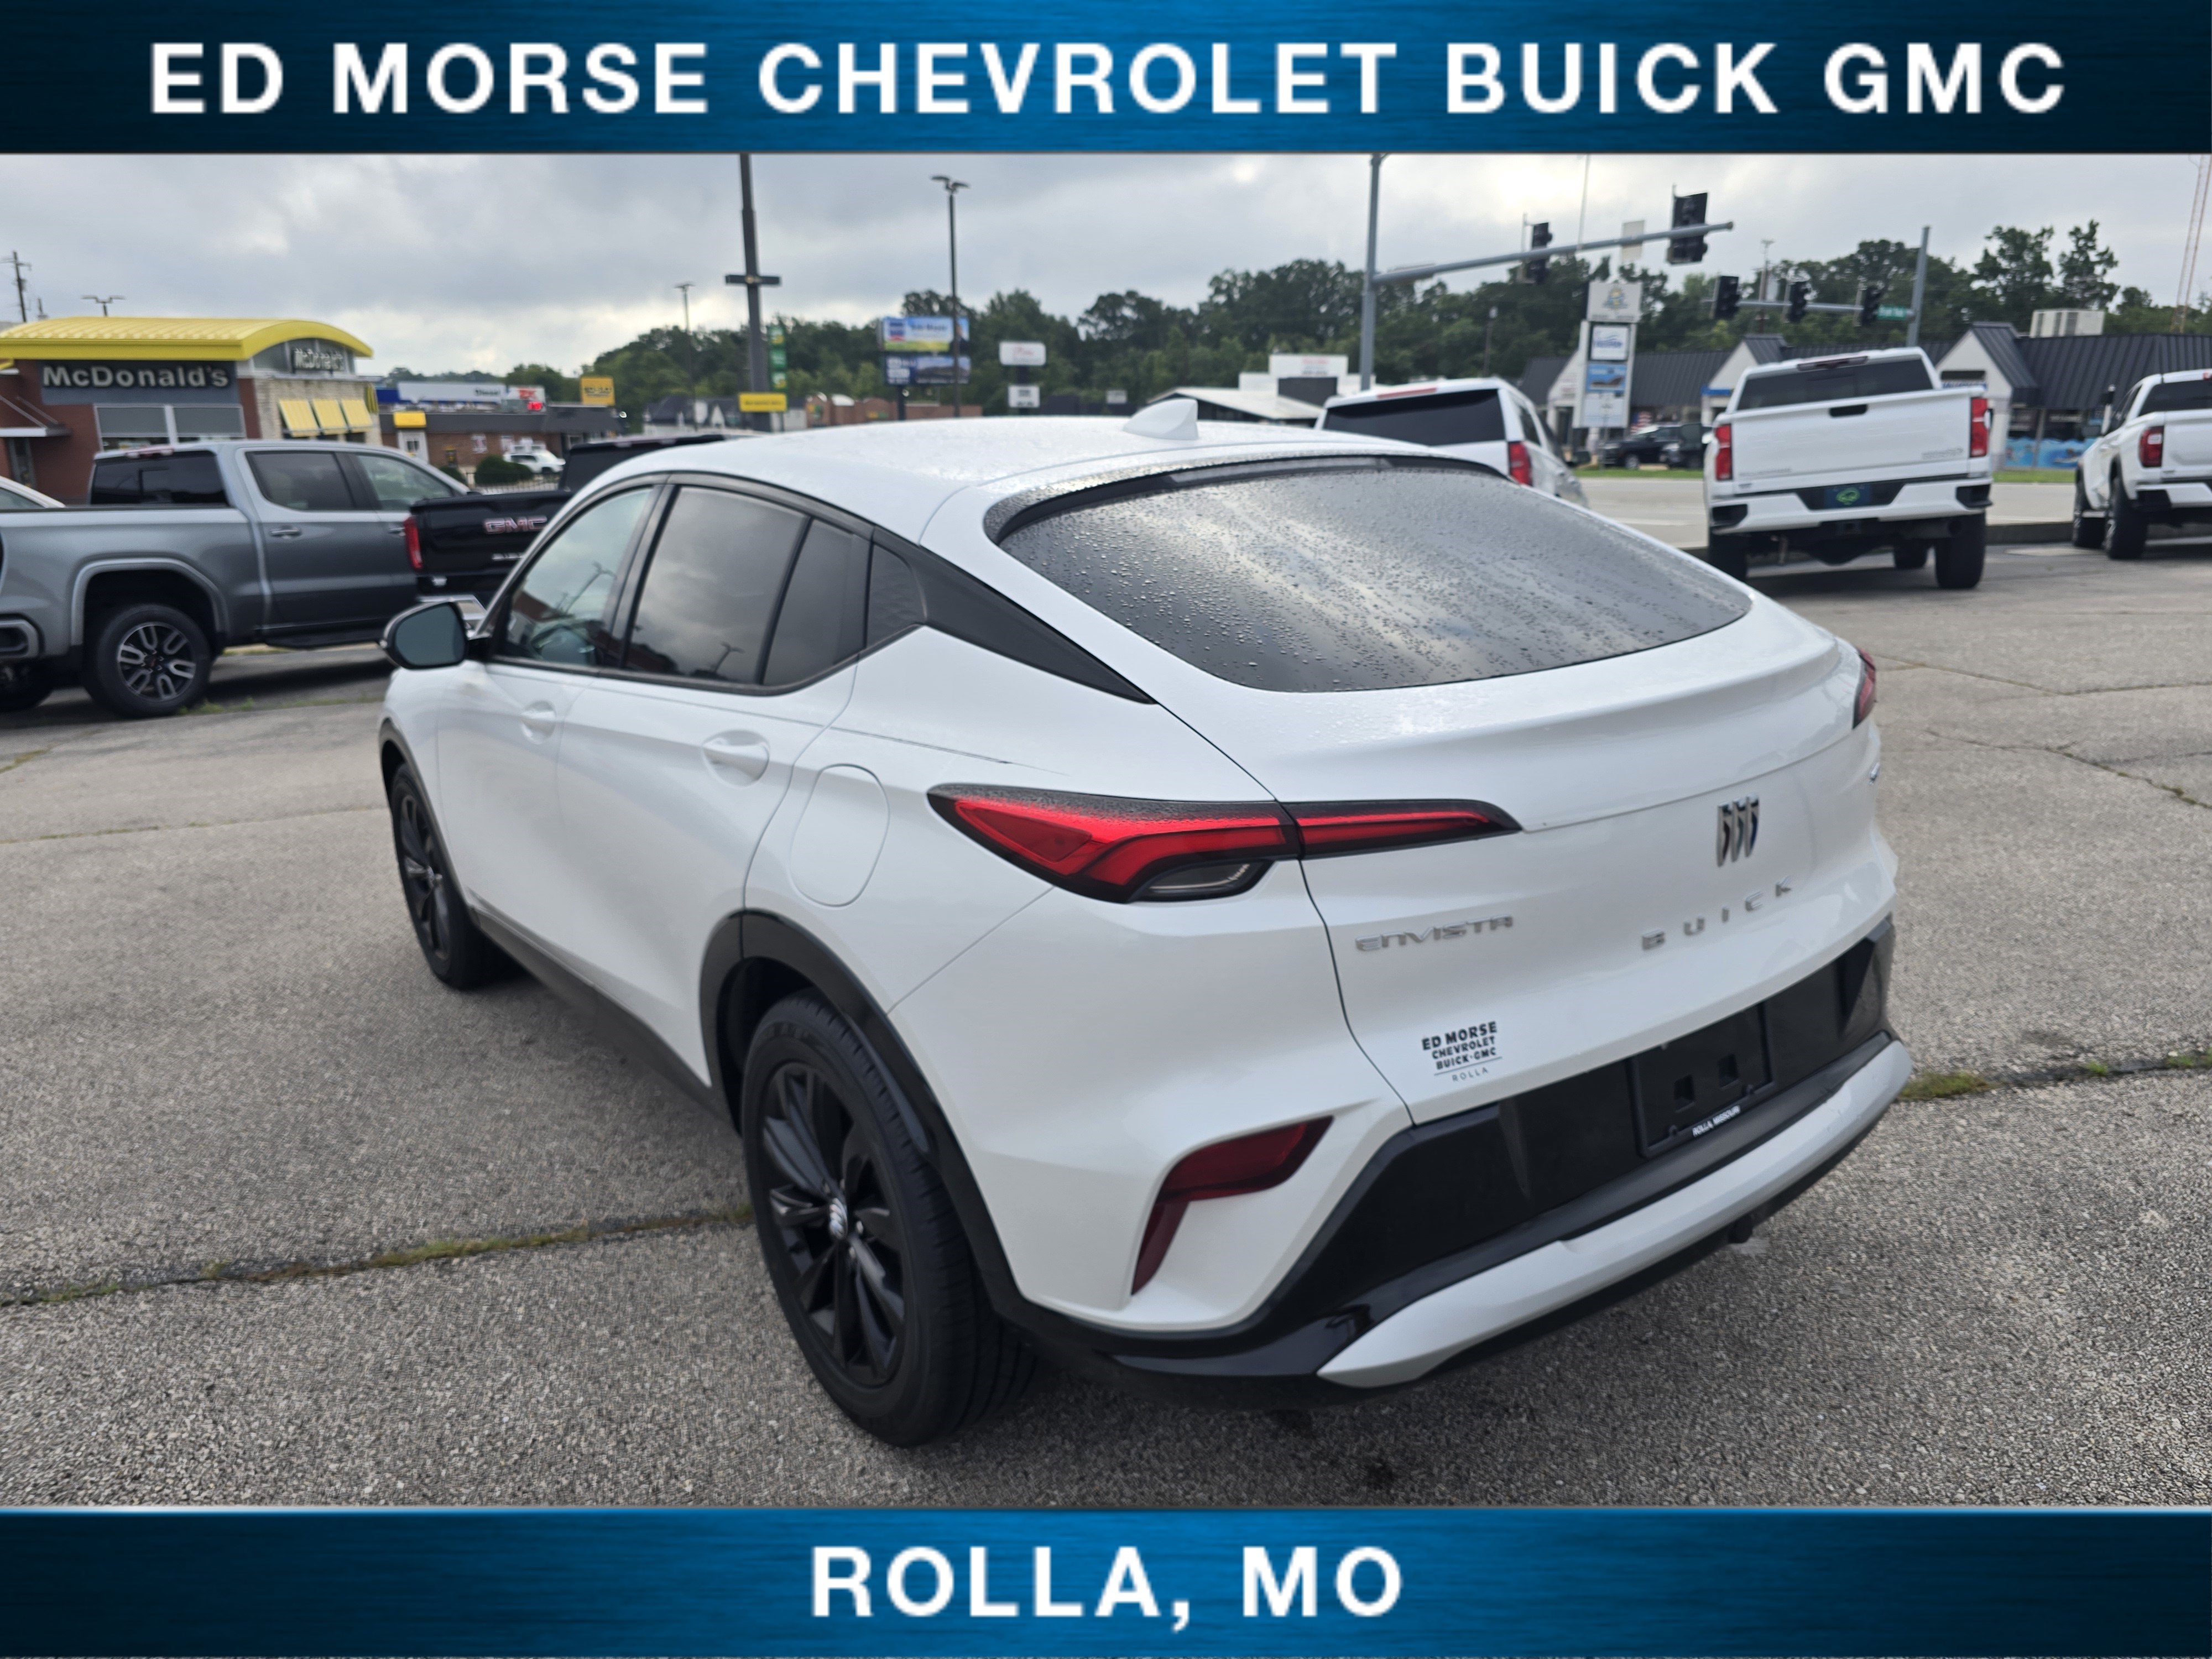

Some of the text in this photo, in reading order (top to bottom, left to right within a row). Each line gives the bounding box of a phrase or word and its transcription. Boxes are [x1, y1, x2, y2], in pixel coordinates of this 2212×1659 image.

[43, 366, 228, 387] McDonald's
[484, 516, 547, 534] GMC
[1641, 876, 1792, 951] BUICK
[1355, 916, 1514, 952] ENVISTA
[1421, 1021, 1498, 1051] ED MORSE
[1431, 1035, 1495, 1060] CHEVROLET
[1452, 1067, 1488, 1082] ROLLA
